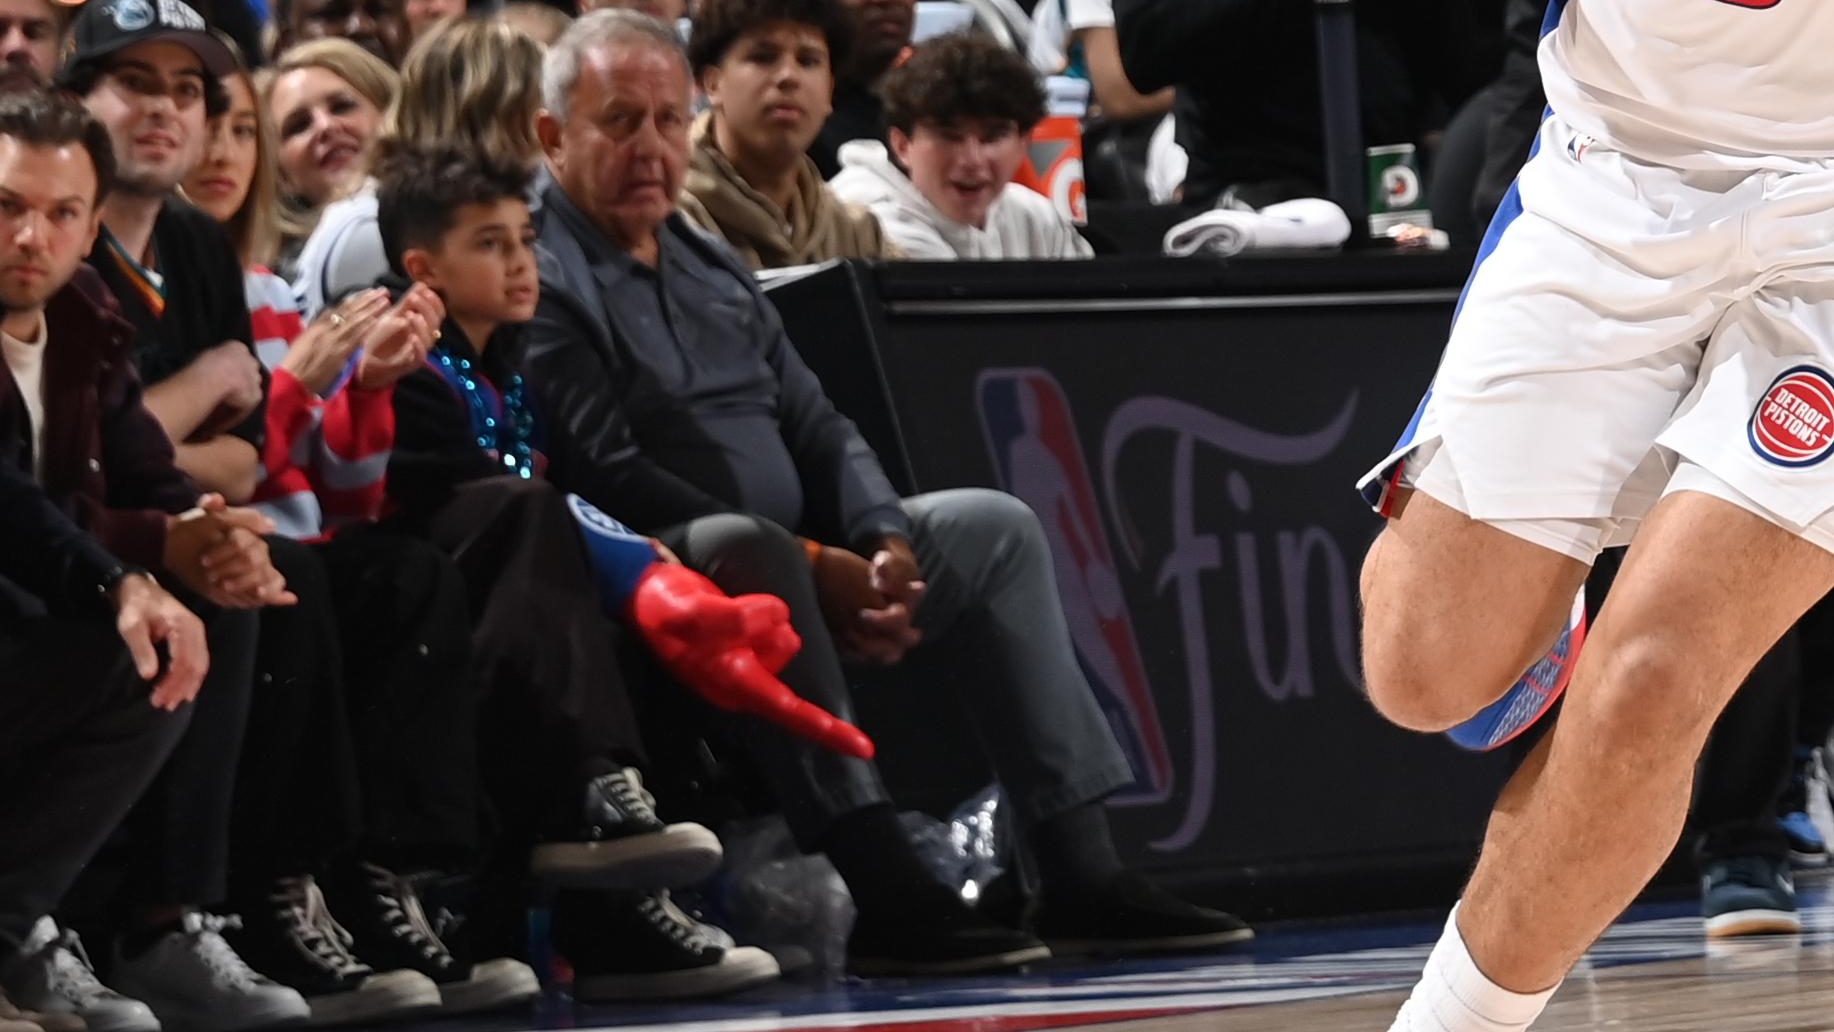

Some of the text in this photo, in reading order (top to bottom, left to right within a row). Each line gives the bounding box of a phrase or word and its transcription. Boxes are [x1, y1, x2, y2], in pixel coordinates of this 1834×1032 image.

[1763, 401, 1821, 447] PISTONS
[1774, 386, 1831, 432] DETROIT
[1103, 386, 1366, 852] Fin
